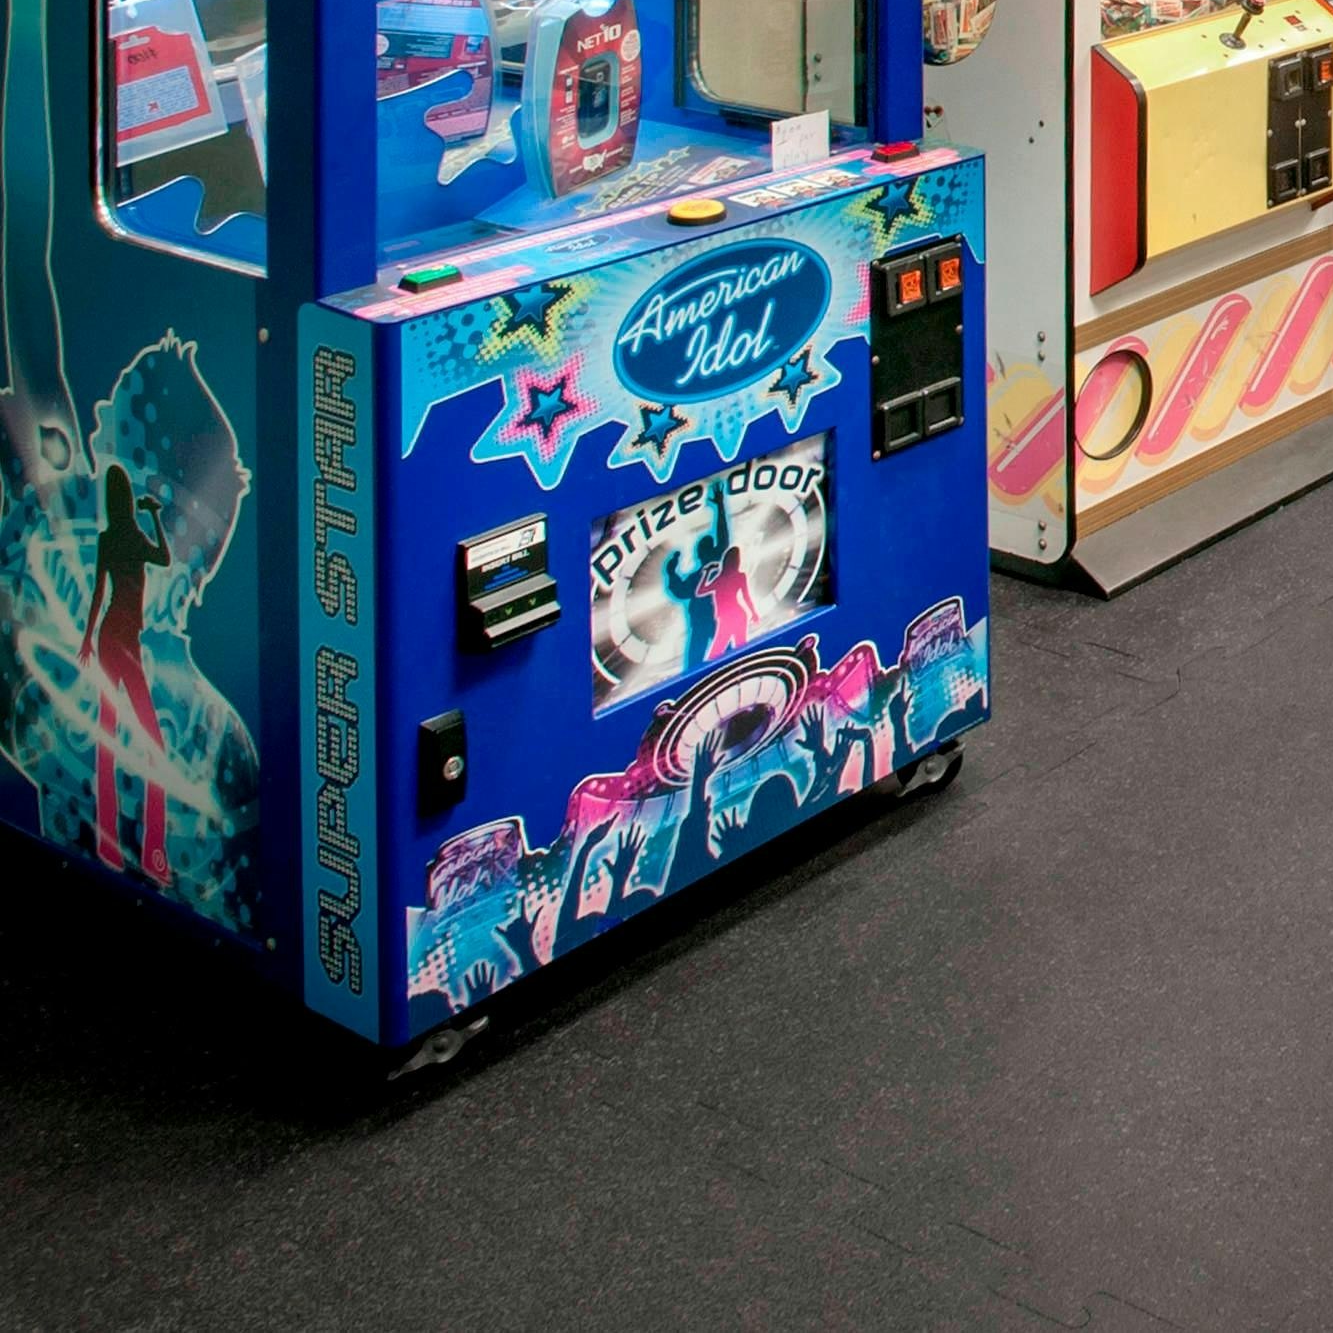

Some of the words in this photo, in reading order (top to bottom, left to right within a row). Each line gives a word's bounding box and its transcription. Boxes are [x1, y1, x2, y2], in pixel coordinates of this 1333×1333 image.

[577, 23, 622, 53] NET10
[619, 252, 804, 353] American
[676, 300, 774, 384] Idol
[313, 345, 358, 627] STAR
[727, 459, 821, 496] door
[592, 483, 704, 585] prize
[316, 645, 363, 997] SUPER
